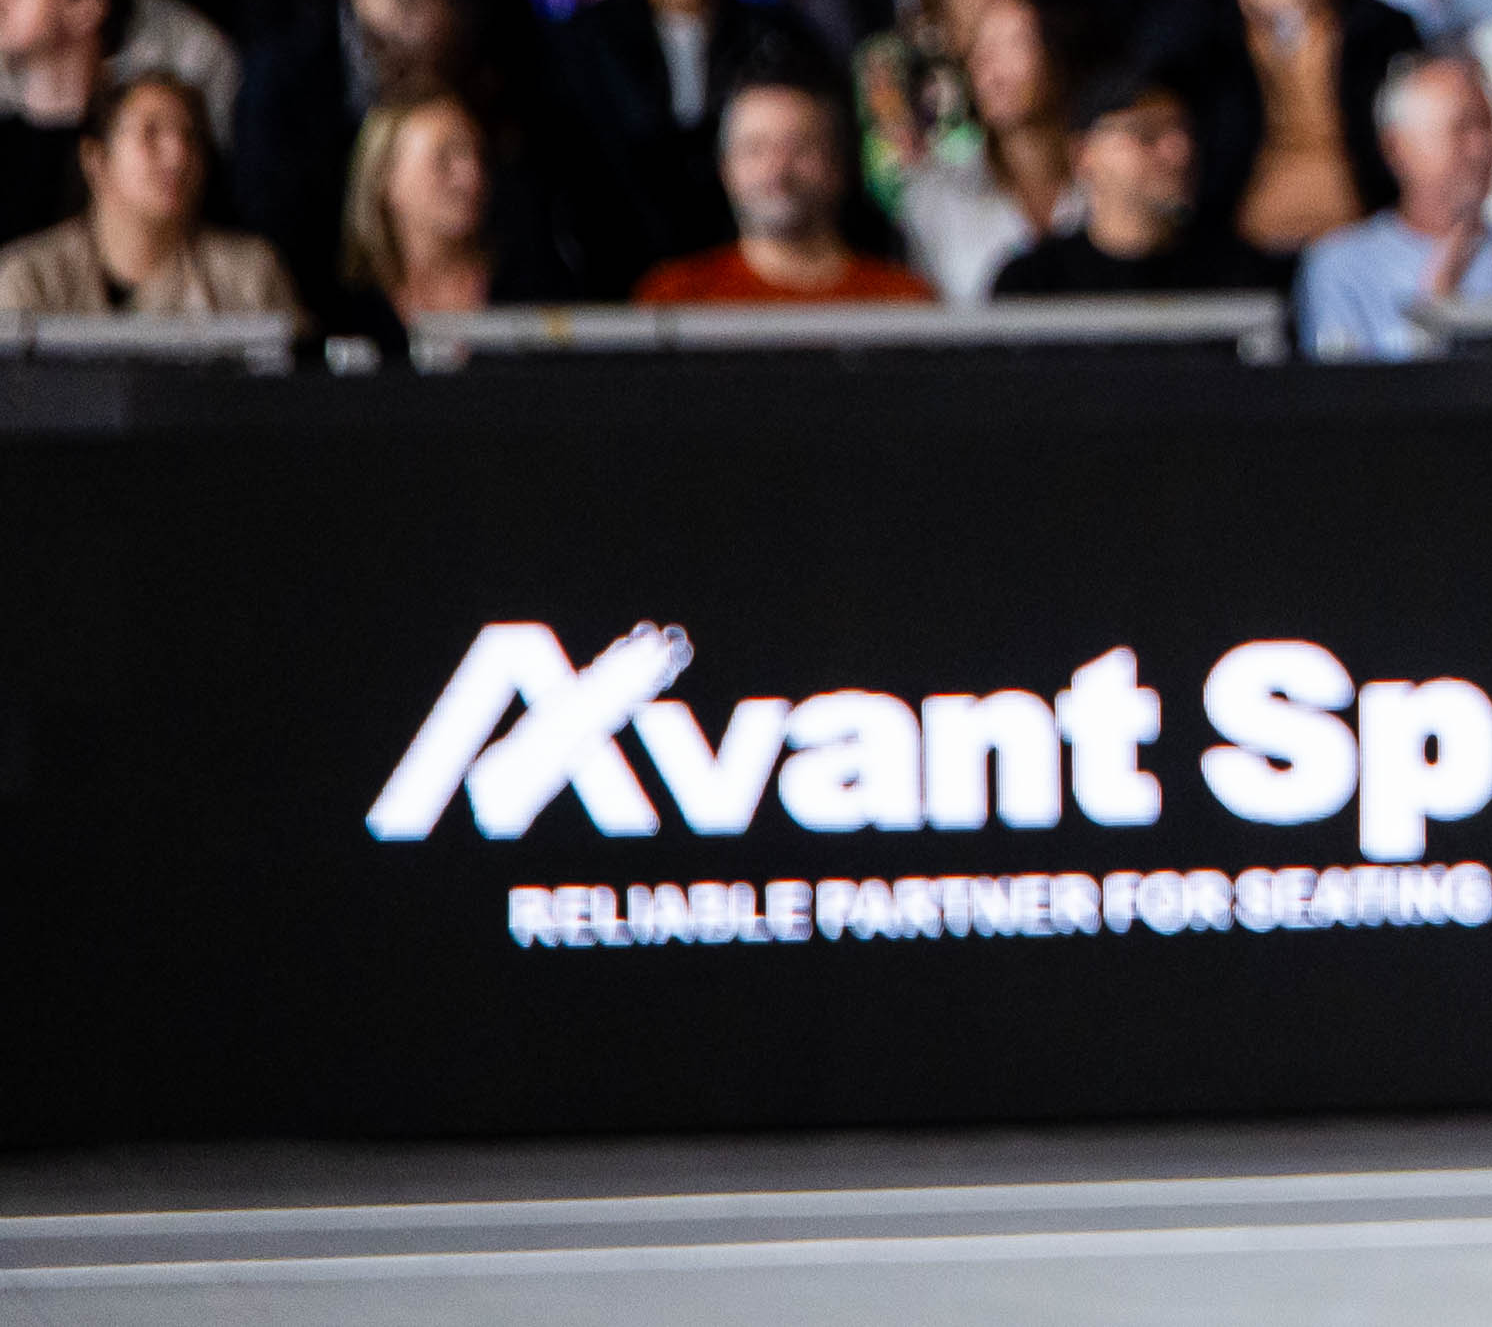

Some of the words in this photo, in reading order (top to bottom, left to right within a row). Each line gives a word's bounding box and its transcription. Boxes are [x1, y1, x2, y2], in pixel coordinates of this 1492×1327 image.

[507, 880, 813, 949] RELIABLE
[815, 873, 1102, 941] PARTNER
[1102, 868, 1234, 935] FOR
